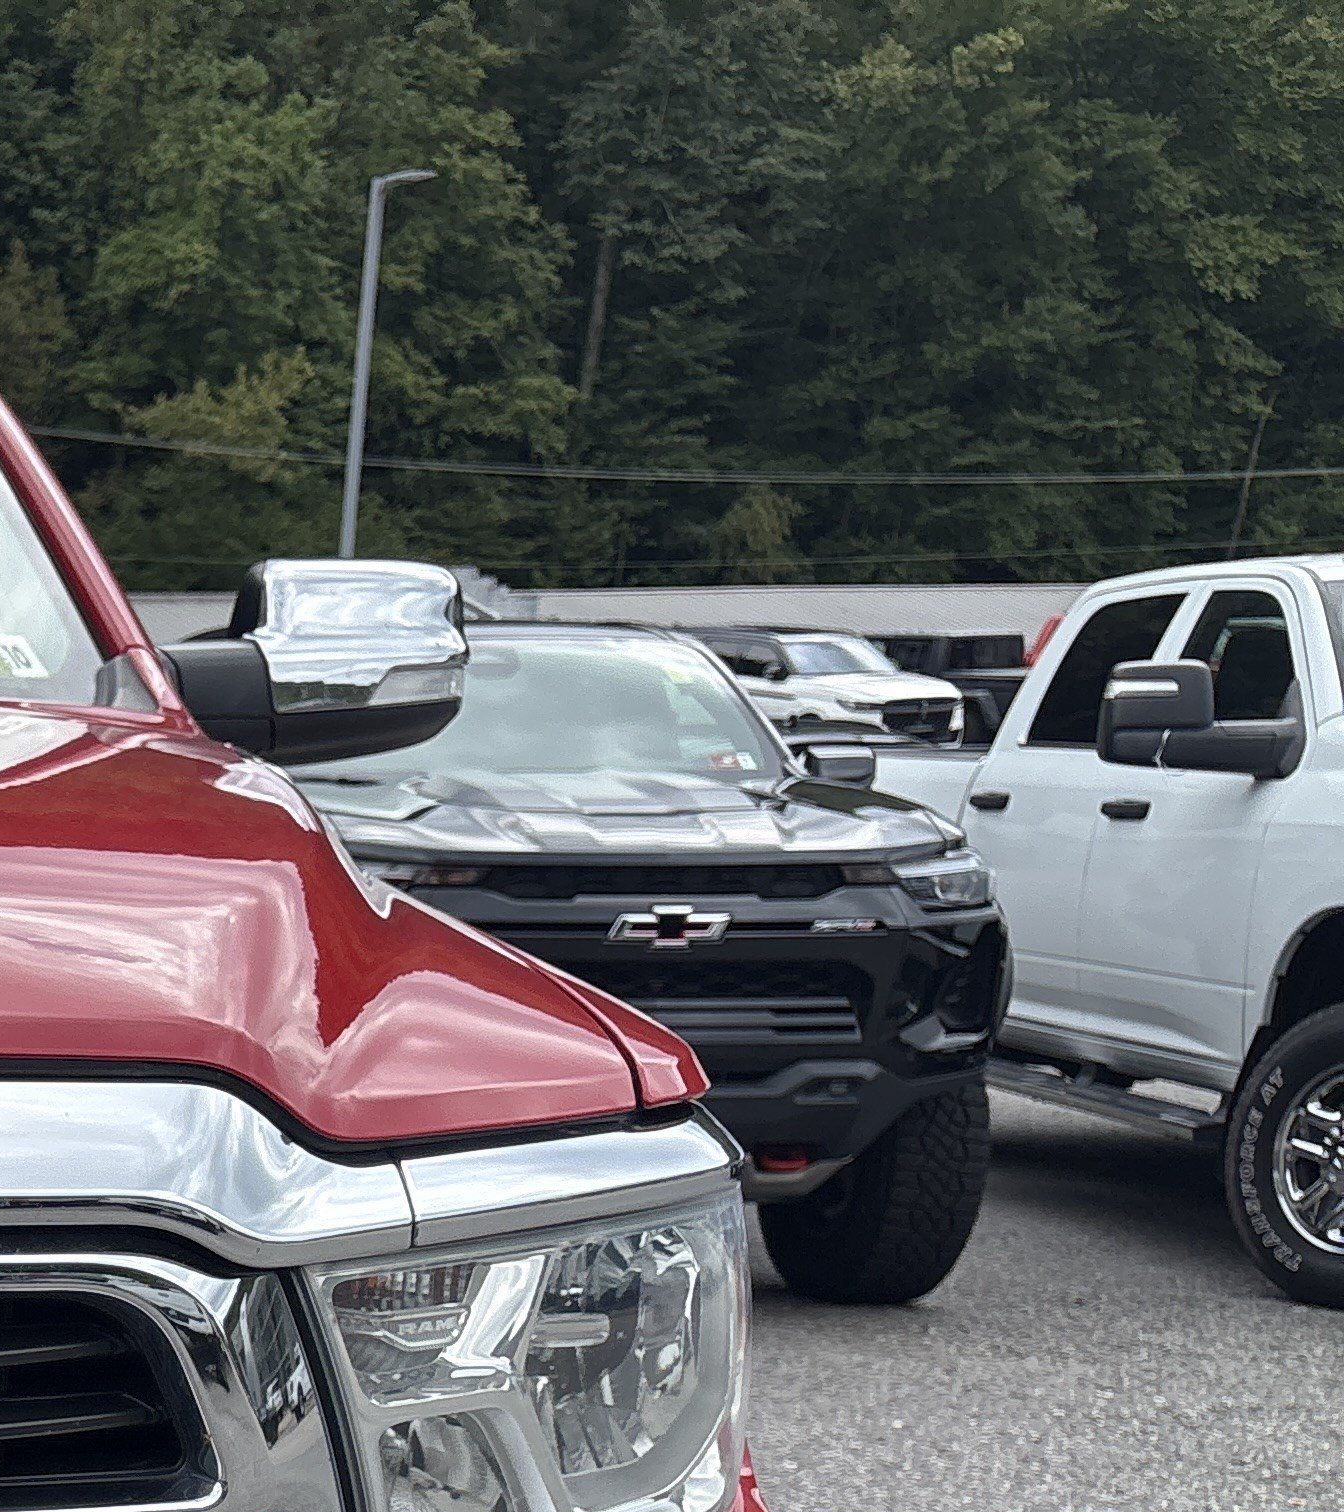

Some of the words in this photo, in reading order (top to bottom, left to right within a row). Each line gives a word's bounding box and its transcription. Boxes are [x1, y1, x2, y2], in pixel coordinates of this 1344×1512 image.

[1261, 1066, 1284, 1105] AT
[1239, 1106, 1303, 1273] TRANSFORCE
[398, 1315, 459, 1336] RAM
